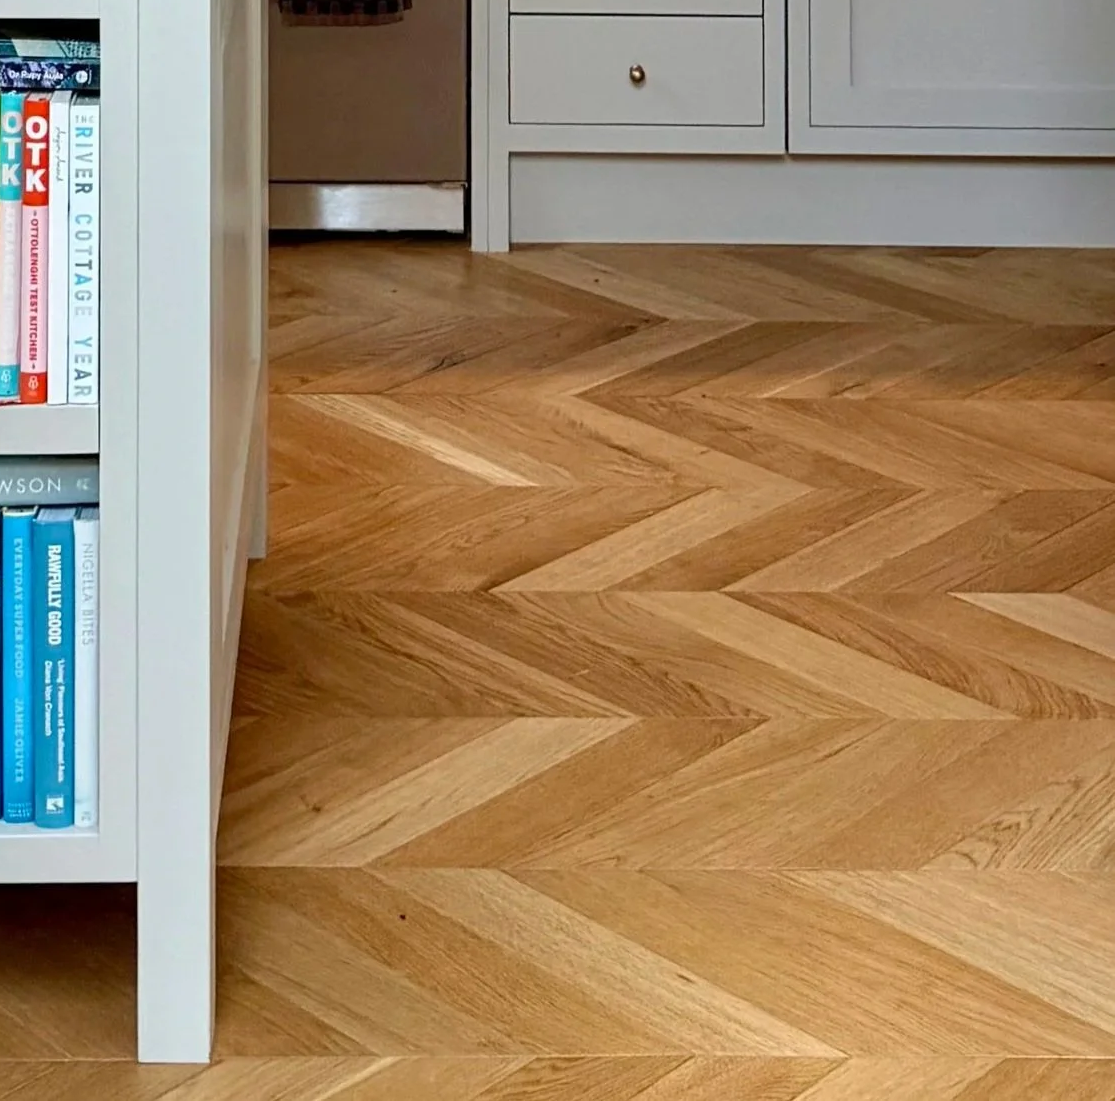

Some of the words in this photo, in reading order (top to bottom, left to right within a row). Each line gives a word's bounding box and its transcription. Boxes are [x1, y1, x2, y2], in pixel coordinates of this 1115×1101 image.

[25, 115, 48, 192] OTK
[75, 127, 93, 194] RIVER
[29, 218, 39, 286] OTTOLENGHI
[75, 214, 93, 316] COTTAGE
[29, 288, 39, 313] TEST
[28, 315, 38, 361] KITCHEN
[74, 336, 93, 397] YEAR
[14, 537, 23, 601] EVERYDAY
[47, 544, 62, 608] RAWFULLY
[81, 542, 95, 603] NIGELLA
[14, 603, 23, 641] SUPER
[47, 610, 62, 645] GOOD
[82, 608, 95, 647] BITES
[14, 644, 23, 678] FOOD
[14, 697, 23, 734] JAMIE
[14, 736, 23, 783] OLIVER
